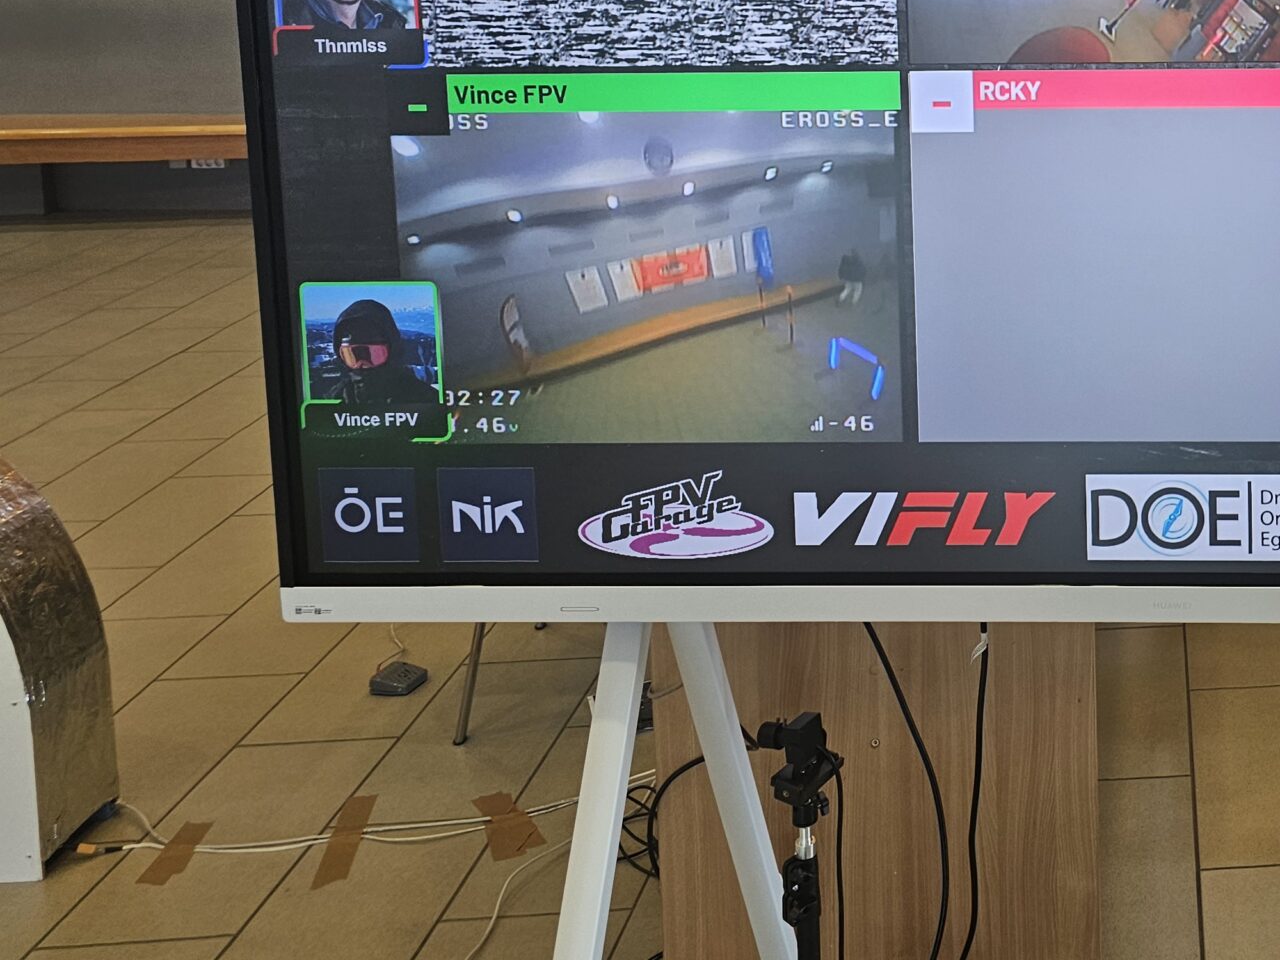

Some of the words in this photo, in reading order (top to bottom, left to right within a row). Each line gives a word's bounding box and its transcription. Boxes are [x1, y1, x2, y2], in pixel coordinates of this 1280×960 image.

[314, 38, 387, 54] Thnmlss
[454, 84, 518, 105] Vince
[523, 83, 568, 104] FPV
[979, 80, 1040, 102] RCKY
[334, 412, 380, 428] Vince
[384, 411, 418, 427] FPV
[622, 470, 723, 515] FPV
[600, 497, 741, 544] Garage
[793, 491, 1056, 546] VIFLY
[1089, 484, 1242, 549] DOE
